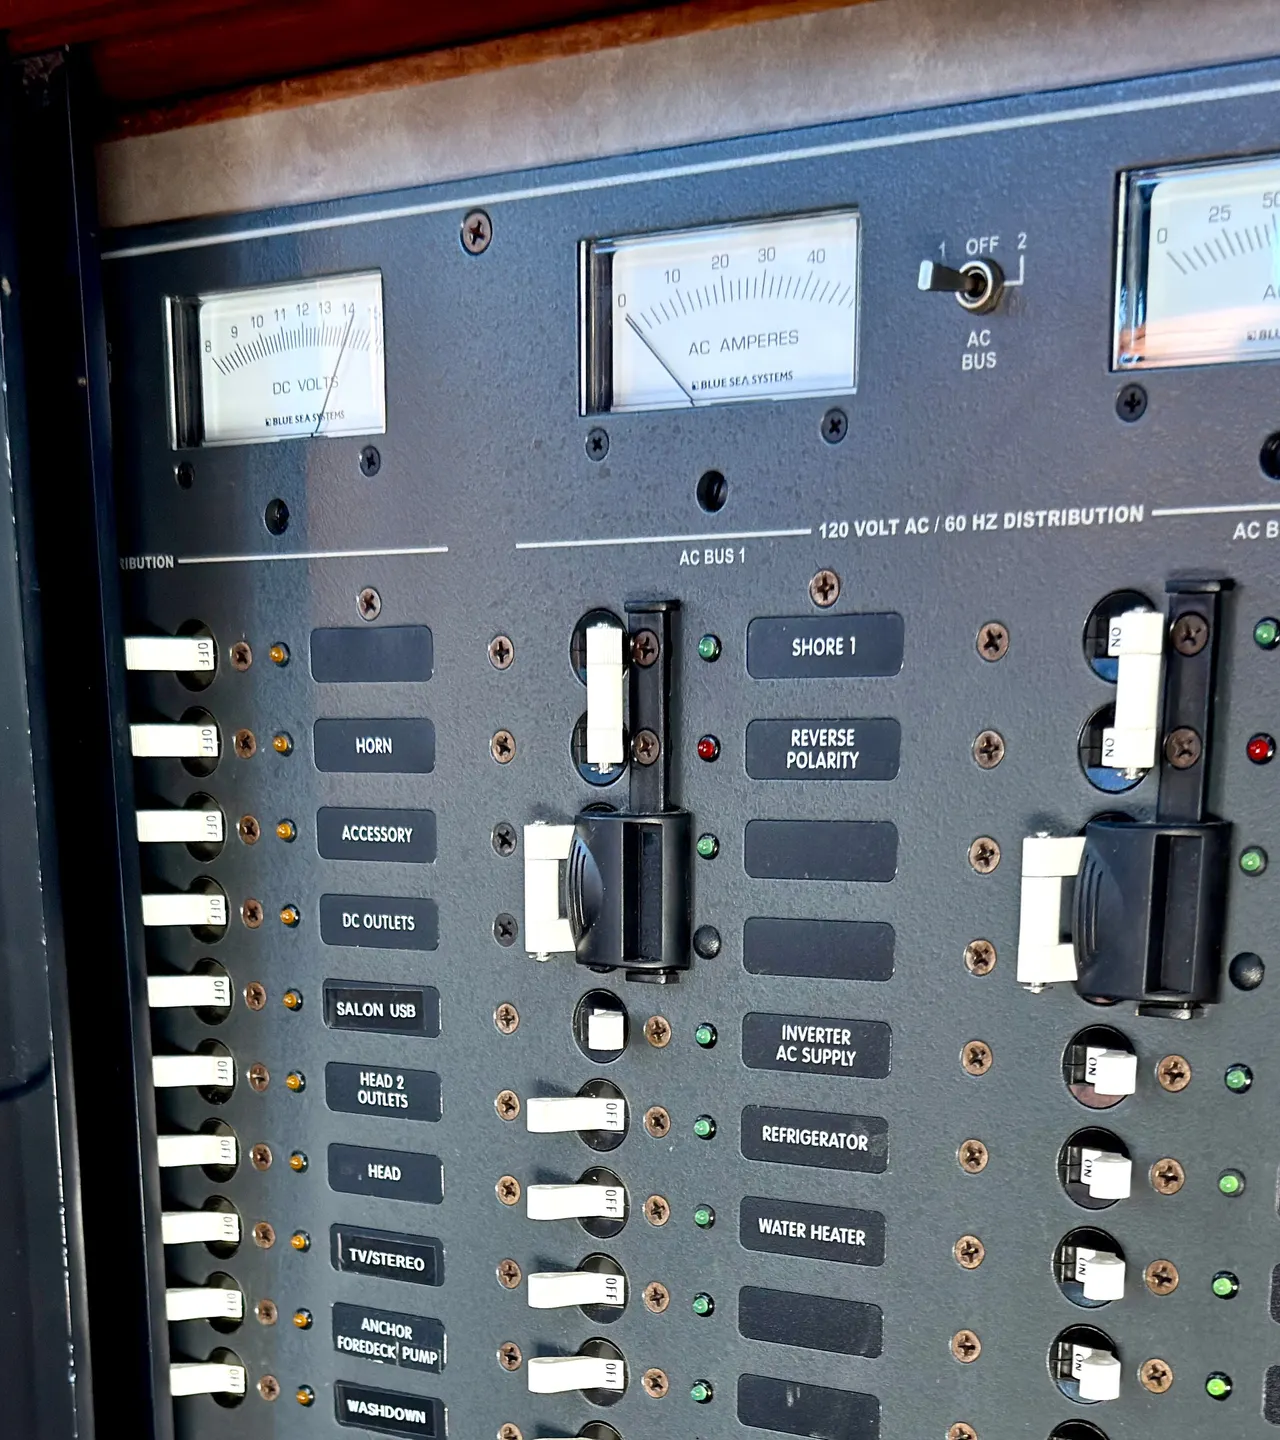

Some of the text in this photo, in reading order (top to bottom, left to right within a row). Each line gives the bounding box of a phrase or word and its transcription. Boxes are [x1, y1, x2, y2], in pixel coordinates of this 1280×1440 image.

[1156, 227, 1168, 245] 0
[1208, 205, 1231, 224] 25
[965, 231, 1028, 256] OFF 2
[617, 247, 826, 308] 0 10 20 30 40
[205, 340, 212, 353] 8
[231, 325, 238, 339] 9
[251, 315, 264, 329] 10
[274, 308, 286, 322] 11
[296, 302, 310, 317] 12
[319, 301, 332, 315] 13
[342, 302, 355, 317] 14
[688, 329, 800, 356] AC AMPERES
[966, 329, 991, 348] AC
[961, 351, 997, 371] BUS
[272, 375, 339, 396] DC VOLTS
[700, 370, 794, 390] BLUE SEA SYSTEMS
[272, 409, 346, 427] BLUE SEA SYSTEMS
[818, 504, 1145, 539] 120 VOLT AC 60 HZ DISTRIBUTION
[1232, 521, 1260, 540] AC
[679, 546, 745, 566] AC BUS 1
[791, 636, 857, 658] SHORE 1
[355, 736, 393, 755] HORN
[790, 728, 856, 748] REVERSE
[785, 751, 860, 771] POLARITY
[341, 824, 414, 844] ACCESSORY
[342, 912, 416, 932] DC OUTLETS
[336, 1002, 417, 1019] SALON USB
[781, 1024, 852, 1047] INVERTER
[776, 1045, 857, 1068] AC SUPPLY
[360, 1071, 406, 1090] HEAD 2
[357, 1090, 409, 1109] OUTLETS
[761, 1125, 869, 1152] REFRIGERATOR
[367, 1162, 402, 1182] HEAD
[758, 1217, 867, 1247] WATER HEATER
[349, 1248, 426, 1272] TV/STEREO
[360, 1317, 414, 1341] ANCHOR
[336, 1335, 439, 1366] FOREDECK PUMP
[347, 1399, 427, 1425] WASHDOWN
